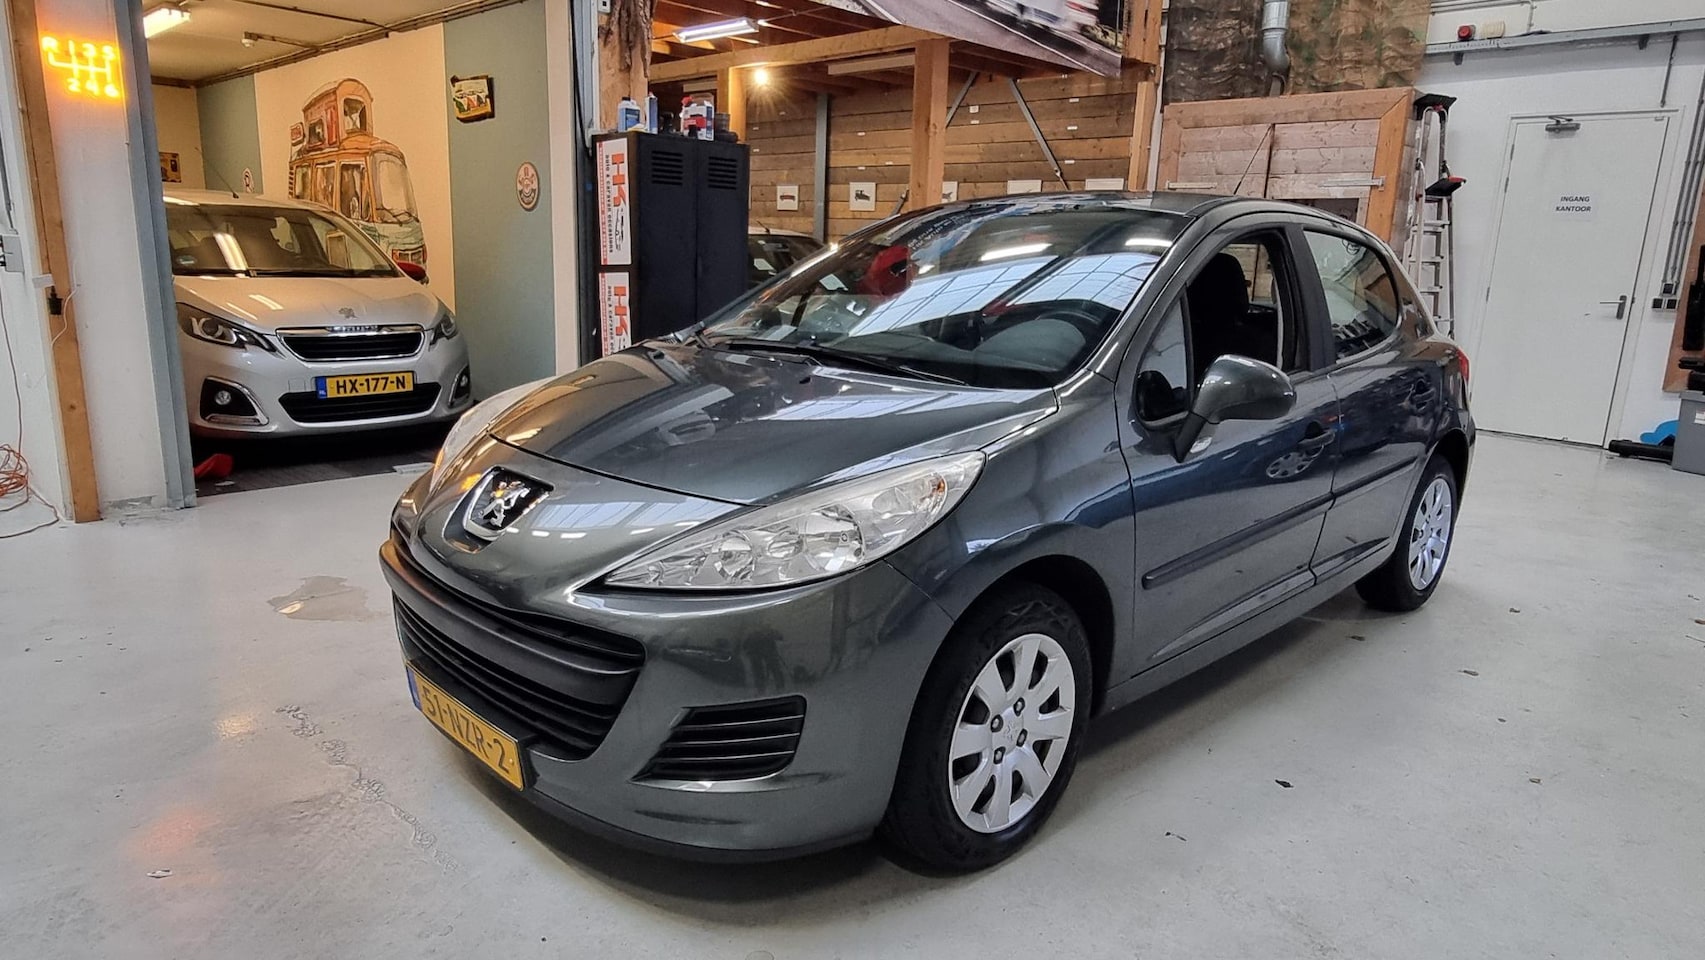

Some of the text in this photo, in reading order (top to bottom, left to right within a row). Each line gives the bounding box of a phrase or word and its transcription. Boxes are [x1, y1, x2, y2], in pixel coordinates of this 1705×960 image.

[82, 42, 97, 58] 3
[102, 44, 116, 61] 5
[66, 77, 81, 93] 2
[85, 79, 100, 96] 4
[336, 375, 406, 395] HX-177-N
[421, 685, 510, 775] 51-NZR-2
